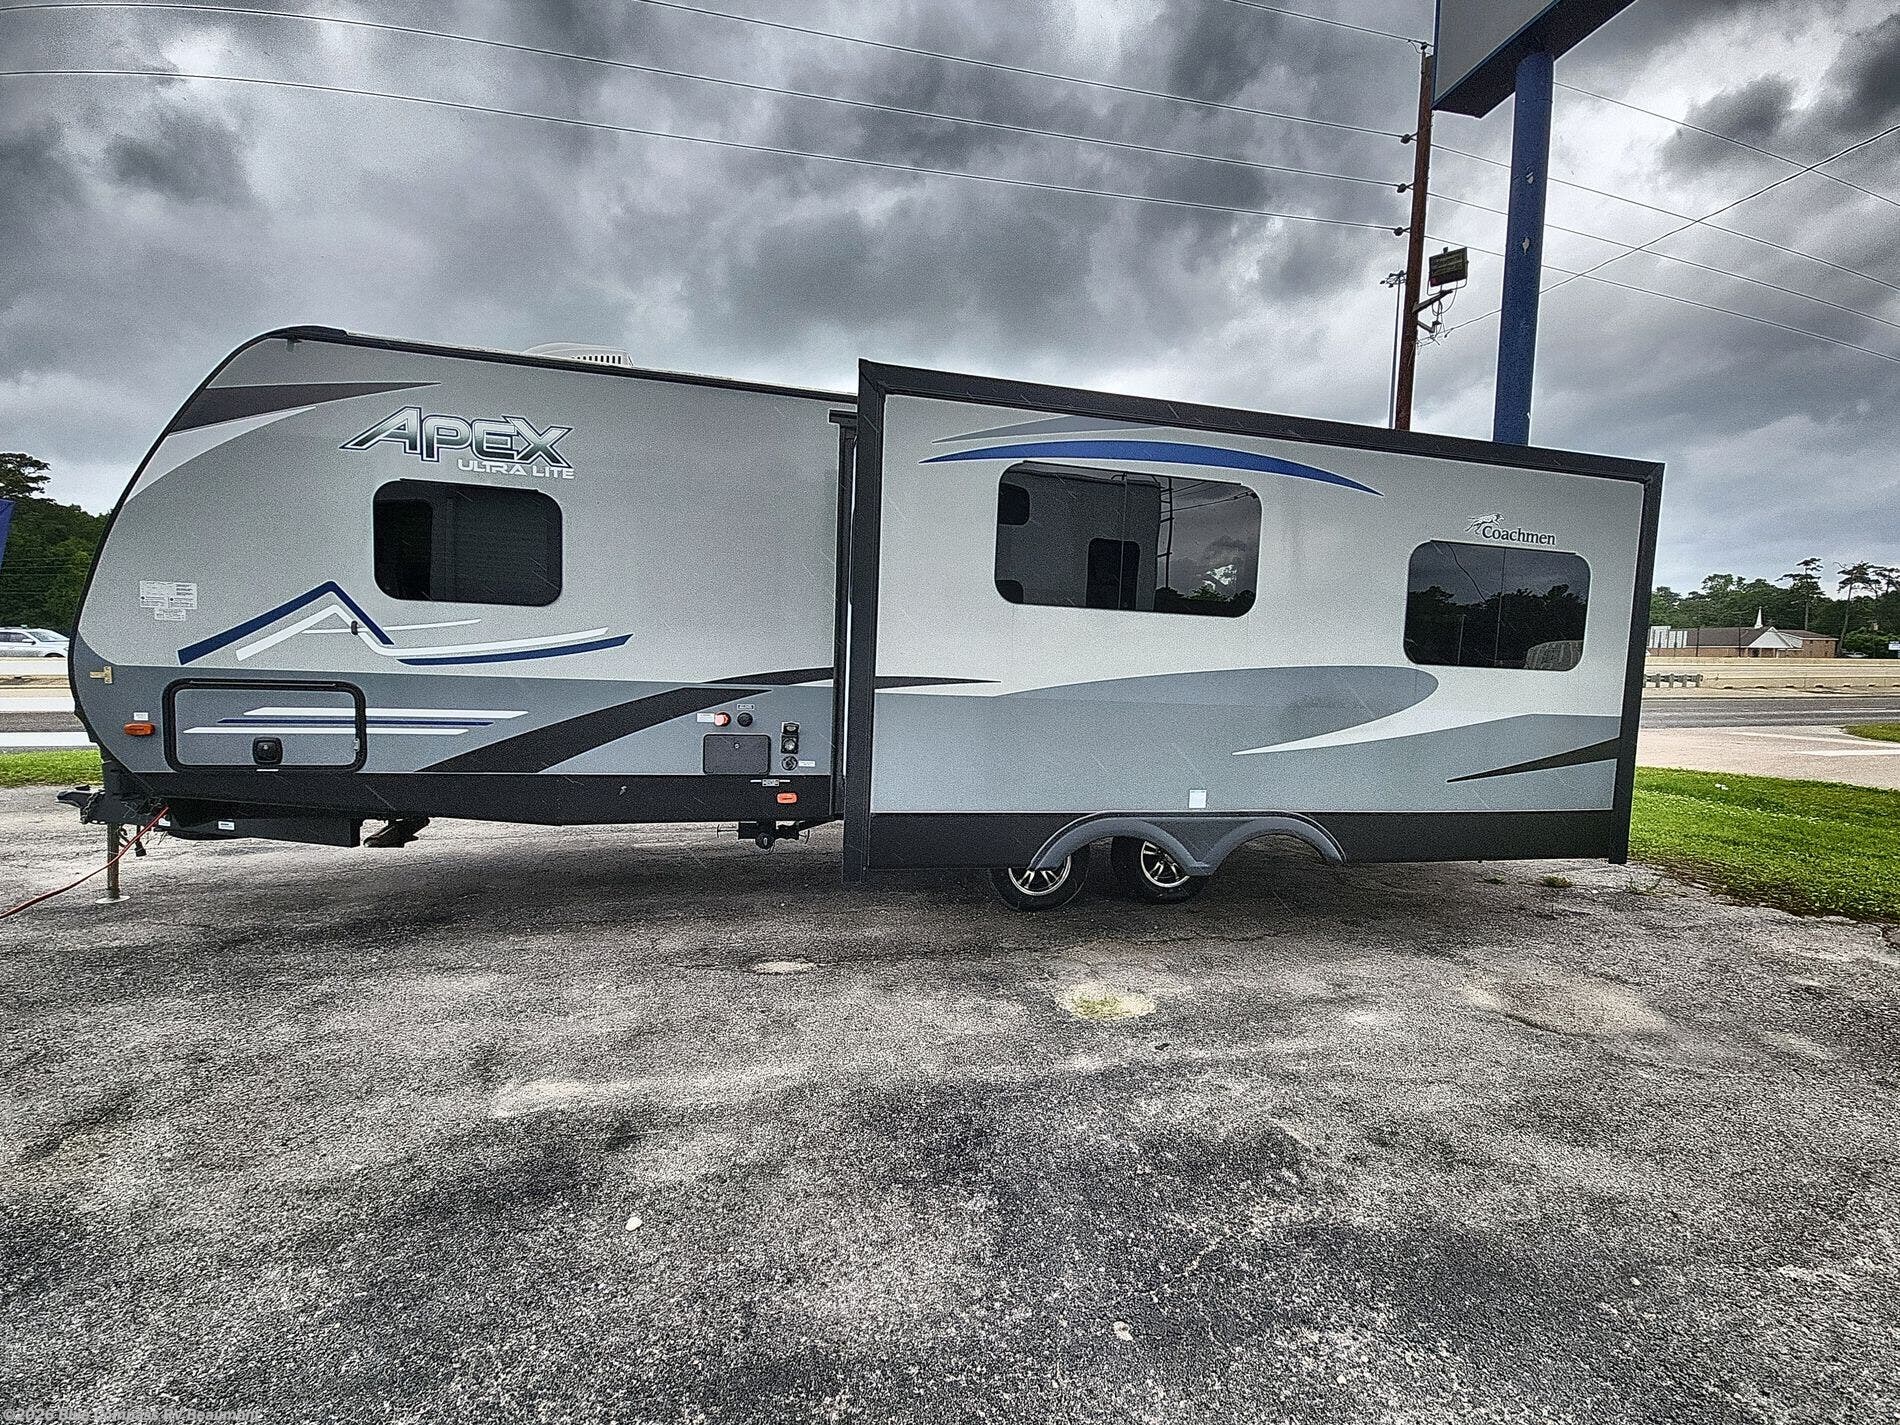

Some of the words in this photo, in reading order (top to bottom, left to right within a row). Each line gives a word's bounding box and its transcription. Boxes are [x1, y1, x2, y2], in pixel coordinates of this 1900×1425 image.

[339, 406, 574, 469] APEX
[457, 458, 528, 477] ULTRA
[532, 466, 575, 480] LITE
[1482, 525, 1555, 545] Coachmen
